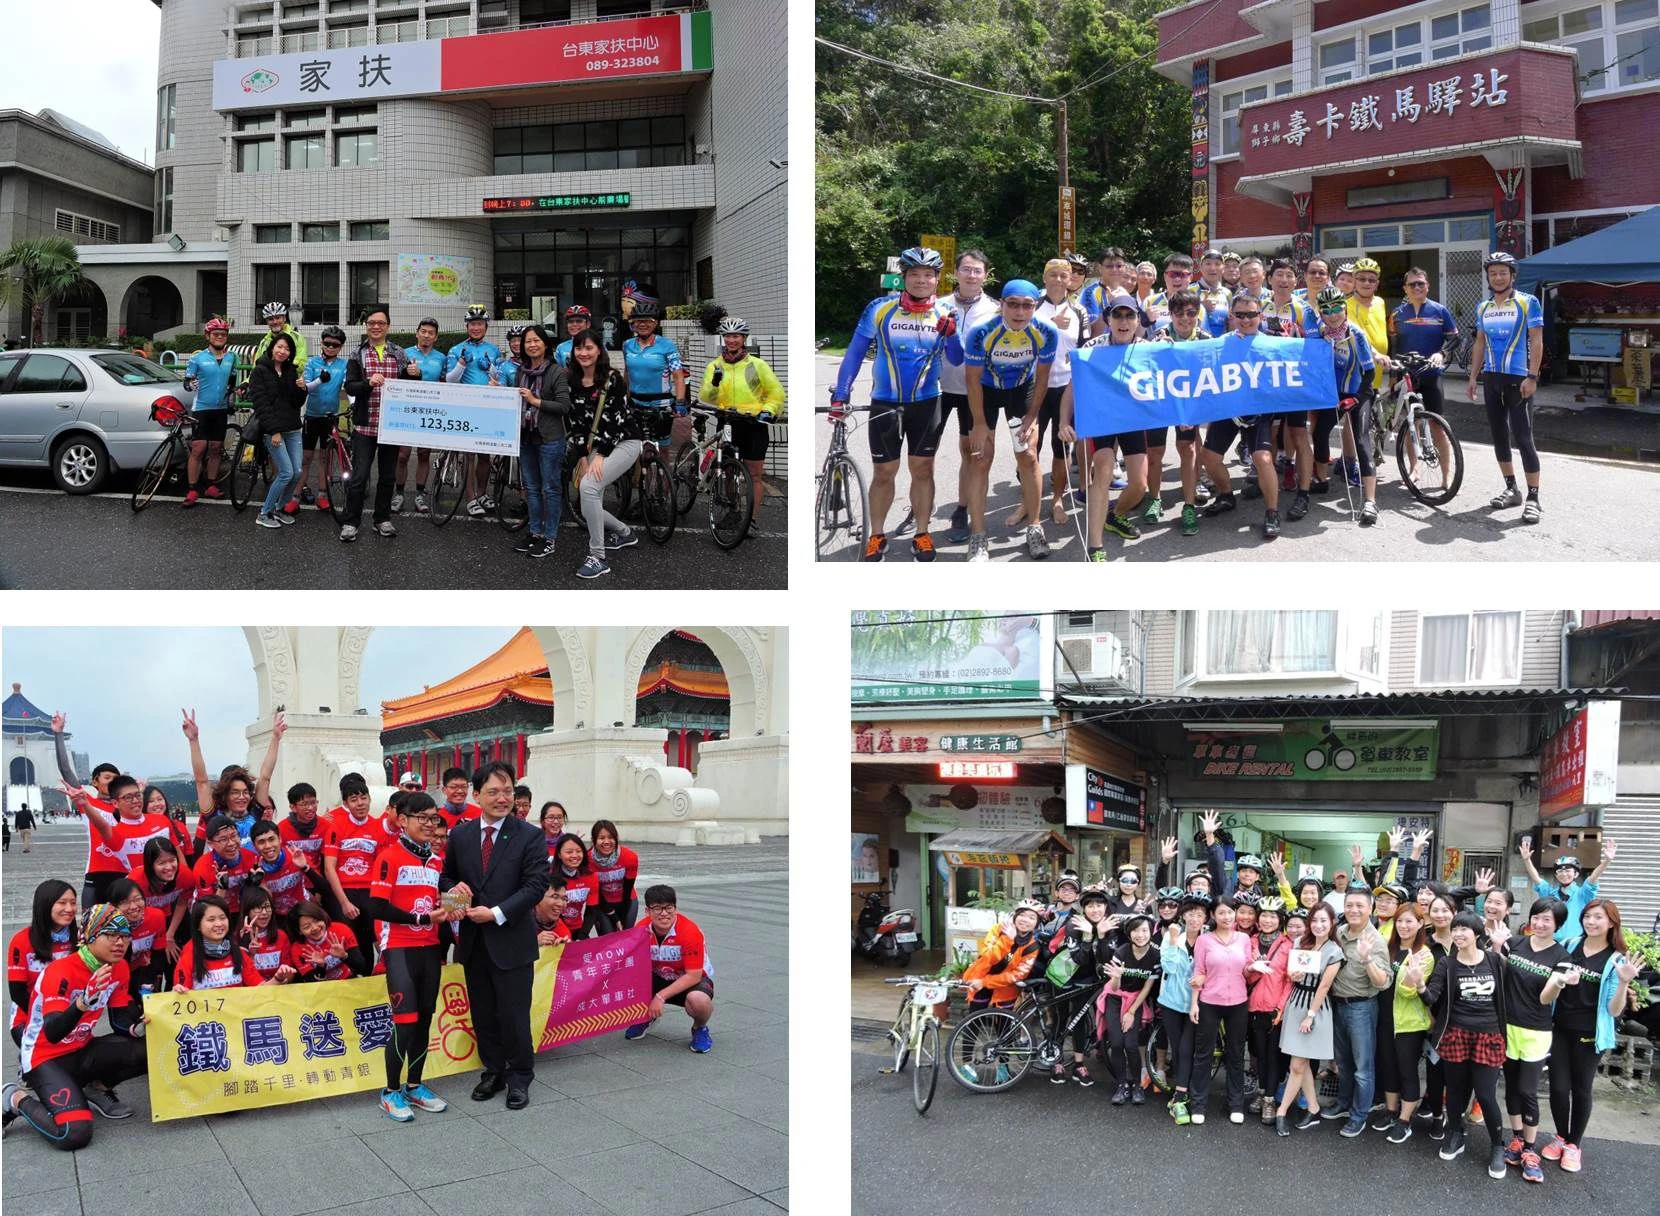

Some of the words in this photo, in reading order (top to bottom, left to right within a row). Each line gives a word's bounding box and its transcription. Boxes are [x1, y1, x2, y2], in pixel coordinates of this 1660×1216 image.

[563, 35, 659, 57] 台東家扶中心
[586, 55, 659, 71] 089-323804
[299, 54, 392, 92] 家扶
[1283, 68, 1509, 146] 壽卡鐵馬驛站
[1484, 311, 1516, 319] GIGABYTE
[891, 323, 937, 333] GIGABYTE
[993, 350, 1033, 358] GIGABYTE
[1128, 361, 1303, 401] GIGABYTE
[403, 406, 447, 416] 台東家扶中心
[941, 738, 1019, 751] 健康生活館
[173, 998, 226, 1015] 2017
[177, 1003, 393, 1076] 鐵馬送愛
